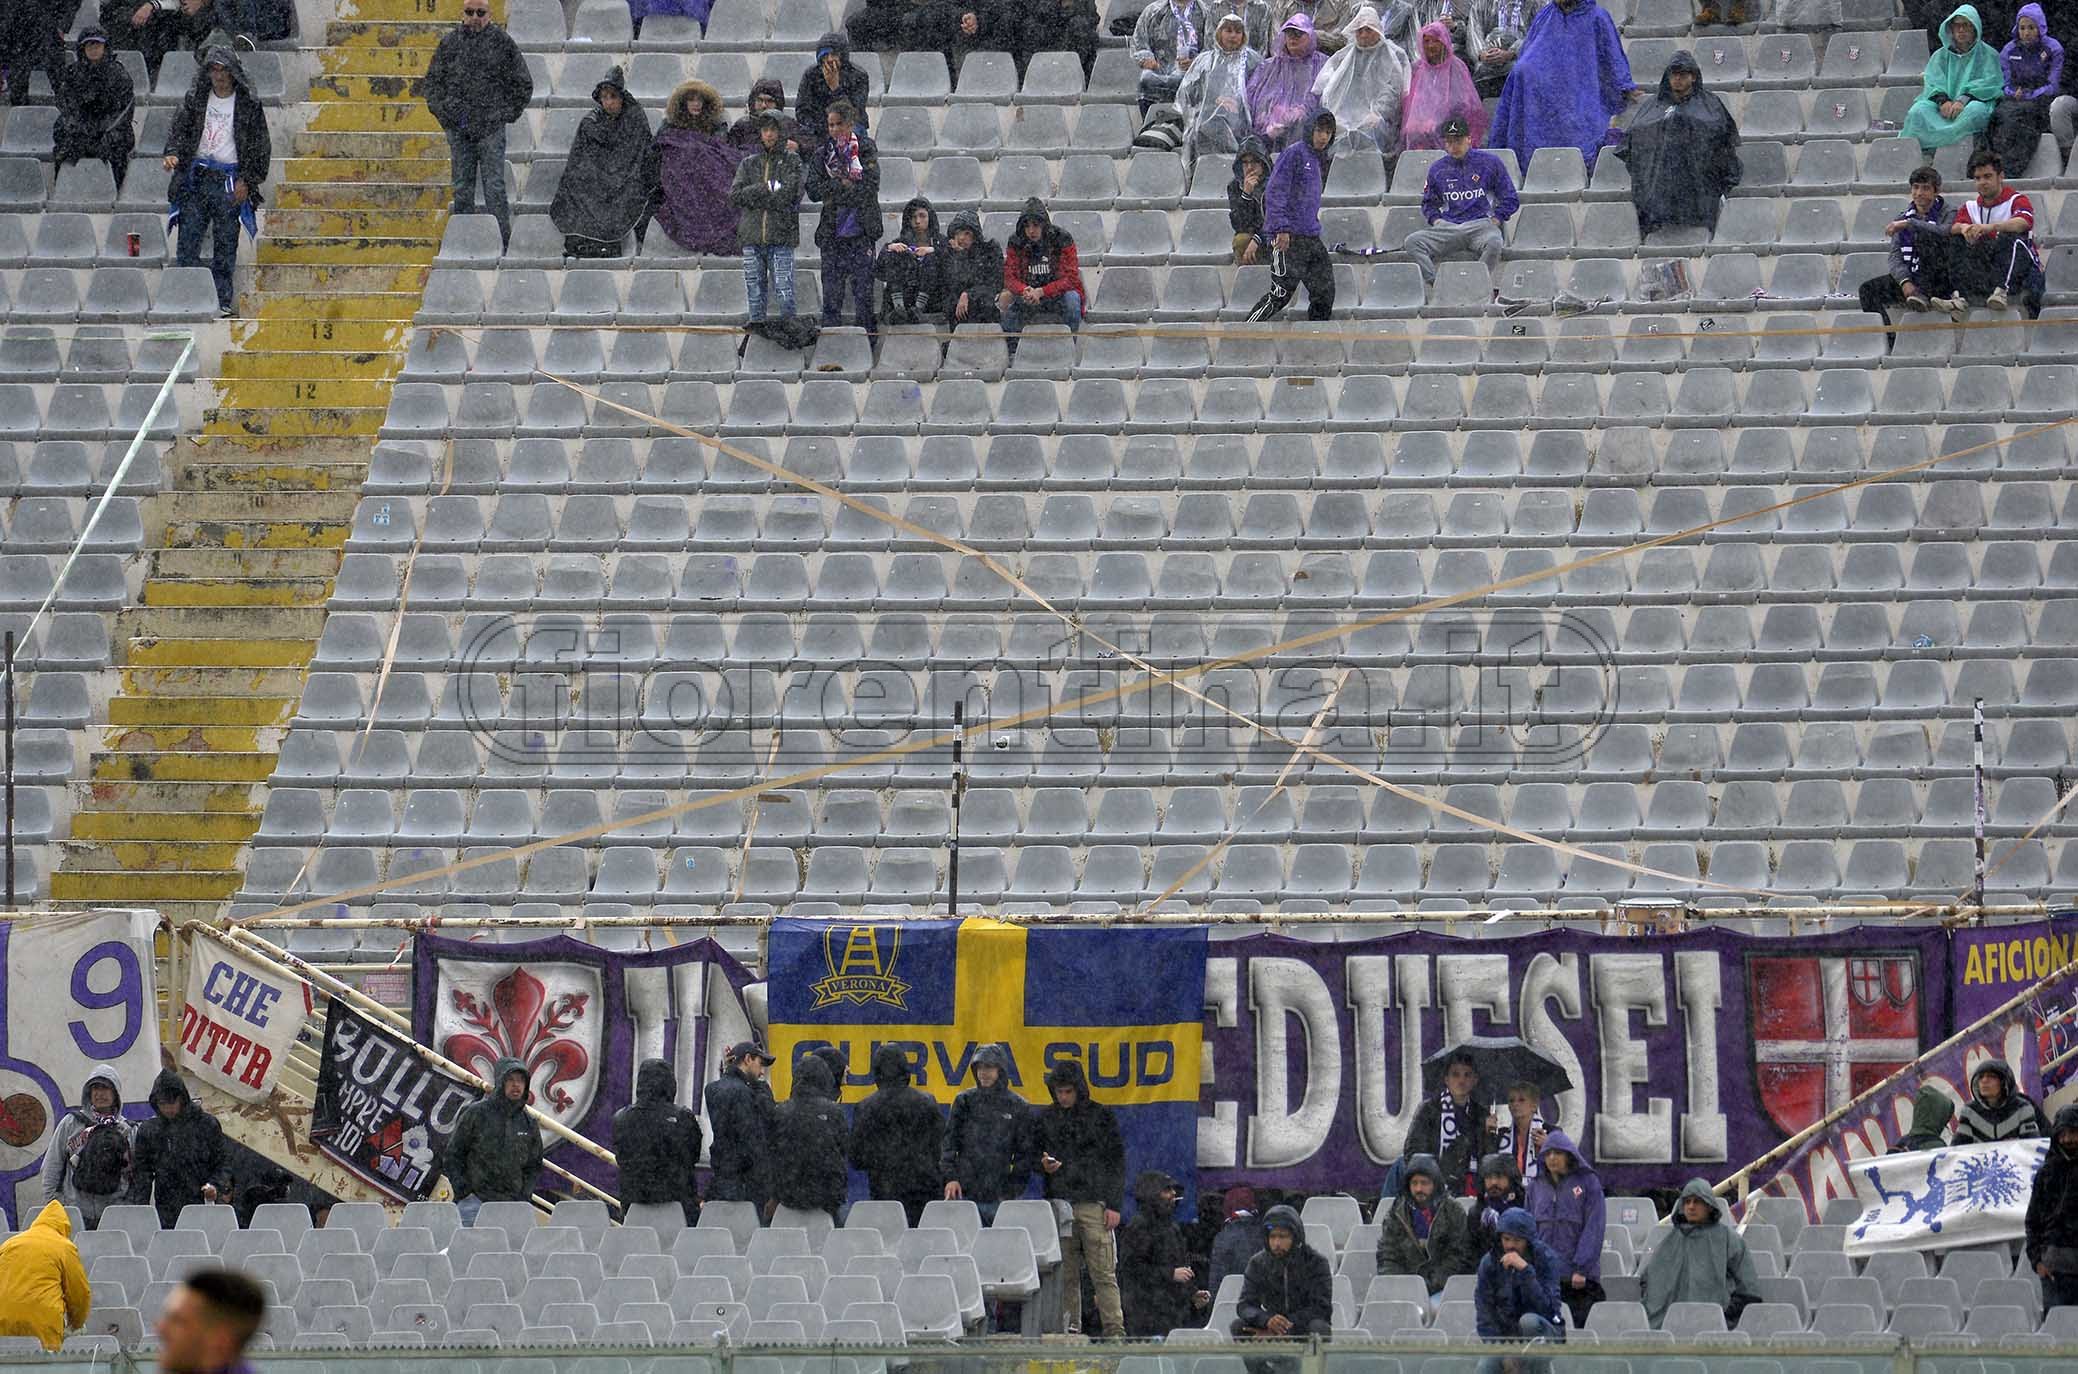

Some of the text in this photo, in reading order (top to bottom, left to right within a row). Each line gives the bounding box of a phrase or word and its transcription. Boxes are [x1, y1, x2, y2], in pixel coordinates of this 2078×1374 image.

[1443, 187, 1485, 201] TOYOTA
[311, 321, 334, 340] 13
[295, 382, 317, 400] 12
[203, 960, 282, 1029] CHE
[831, 979, 886, 992] VERONA
[68, 941, 143, 1060] 9
